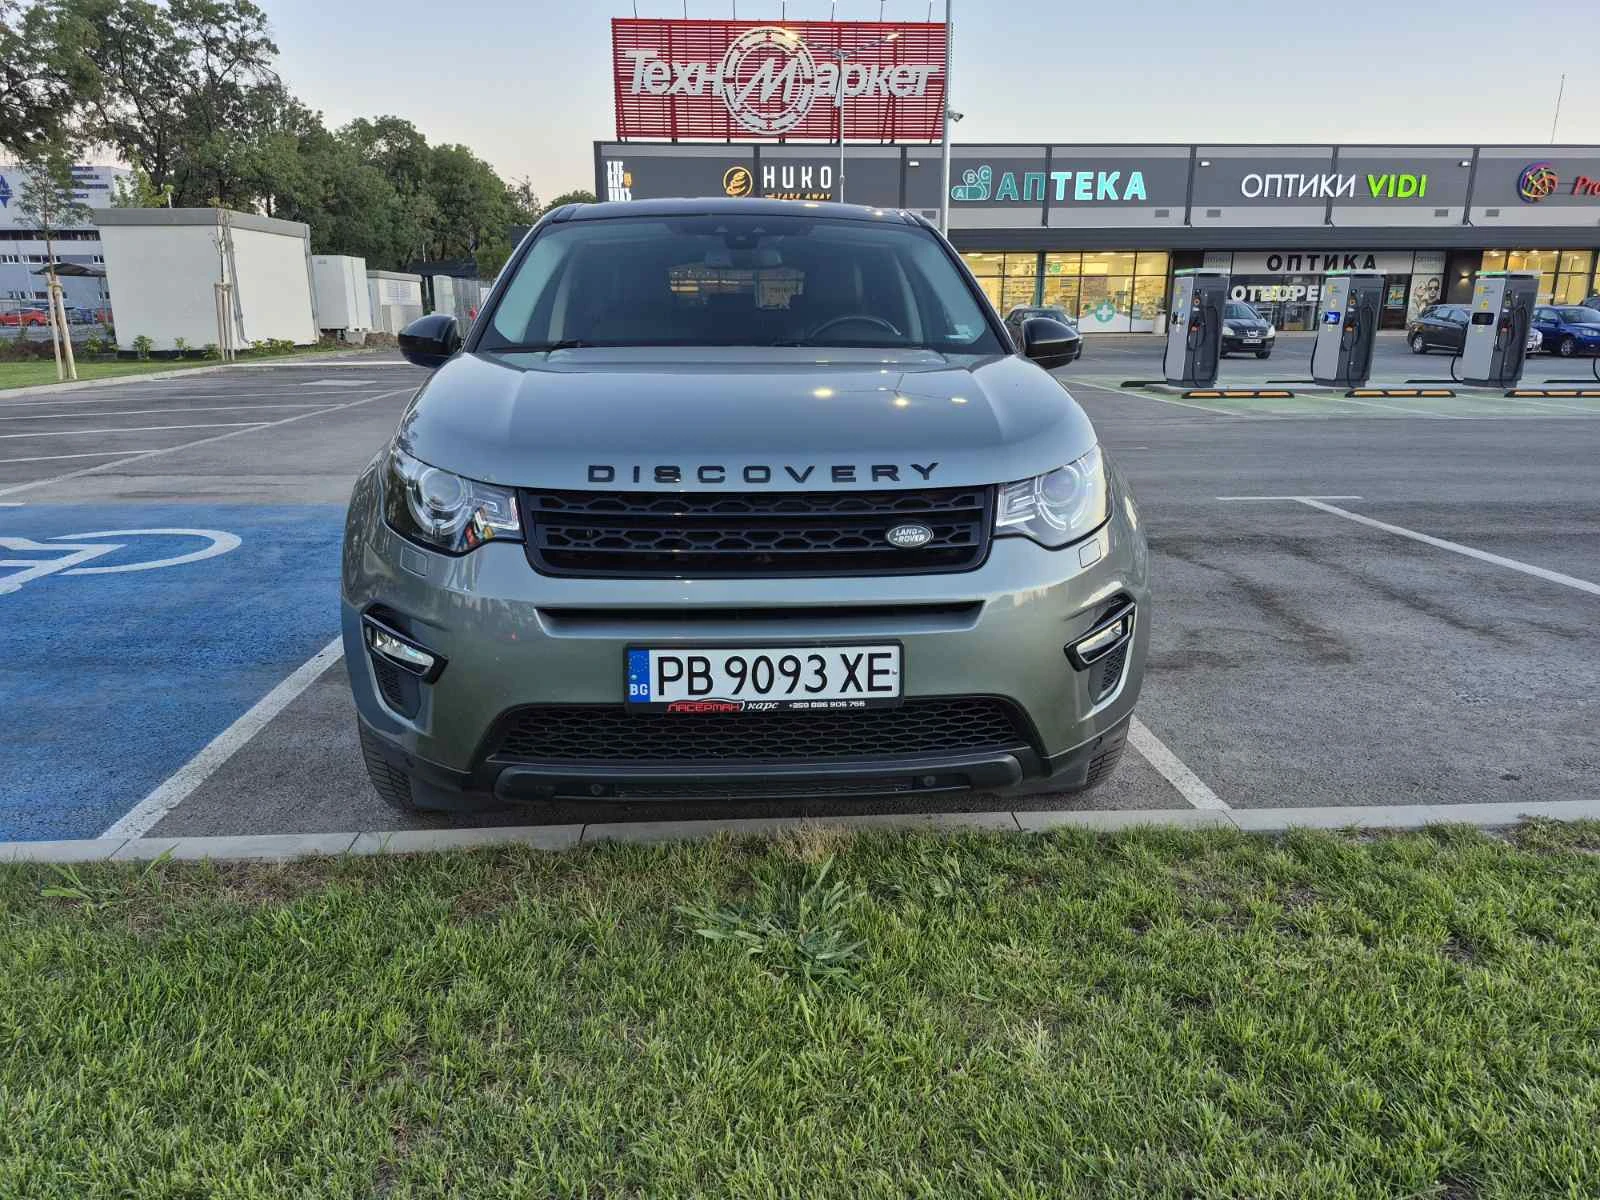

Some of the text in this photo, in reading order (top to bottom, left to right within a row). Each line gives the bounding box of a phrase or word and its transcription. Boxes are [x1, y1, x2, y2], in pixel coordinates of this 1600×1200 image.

[995, 171, 1147, 200] АПТЕКА
[1241, 174, 1428, 198] ОПТИКИ VIDI
[1266, 254, 1377, 272] ОПТИКА
[587, 462, 939, 483] DISCOVERY
[657, 652, 893, 696] PB 9093 XE
[629, 683, 649, 696] BG
